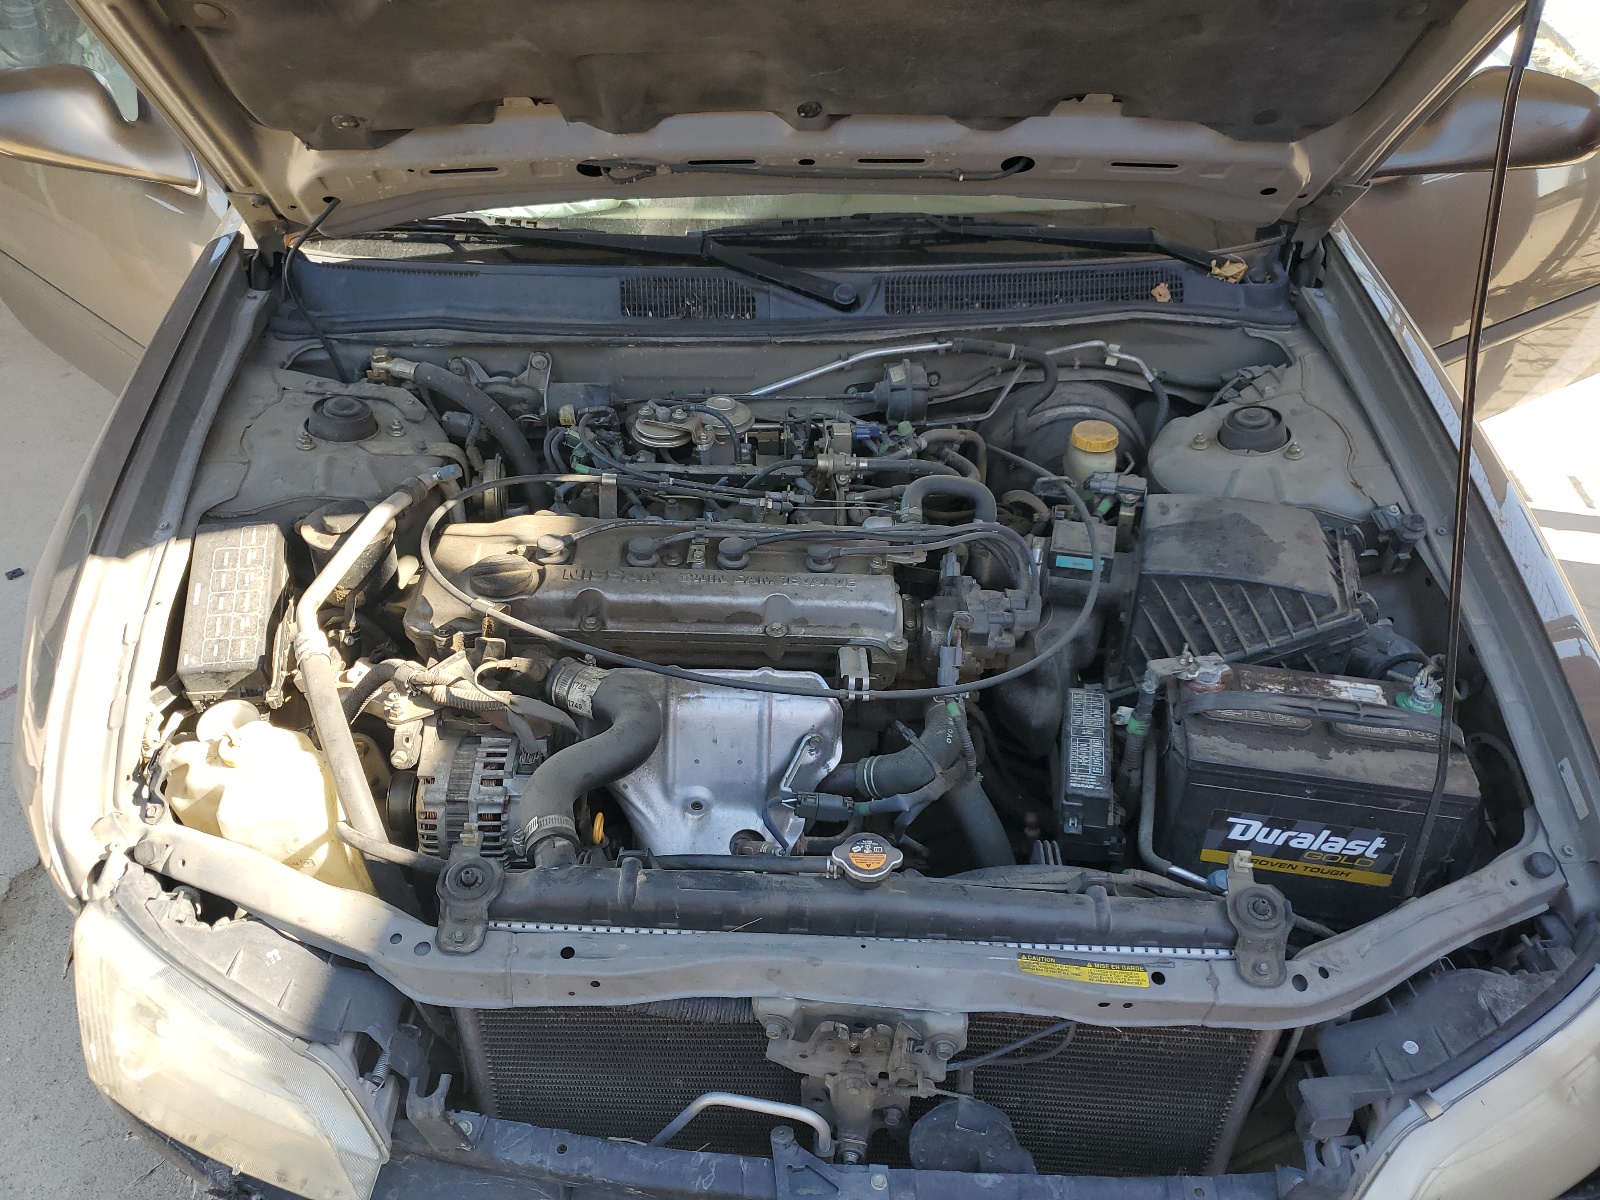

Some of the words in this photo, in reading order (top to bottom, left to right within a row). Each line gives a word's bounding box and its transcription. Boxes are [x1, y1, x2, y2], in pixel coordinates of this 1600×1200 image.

[1226, 817, 1387, 858] Duralast
[1249, 858, 1299, 871] ROVEN
[1303, 865, 1352, 878] TOUGH
[1303, 851, 1375, 868] GOLD
[1027, 954, 1056, 963] CAUTION
